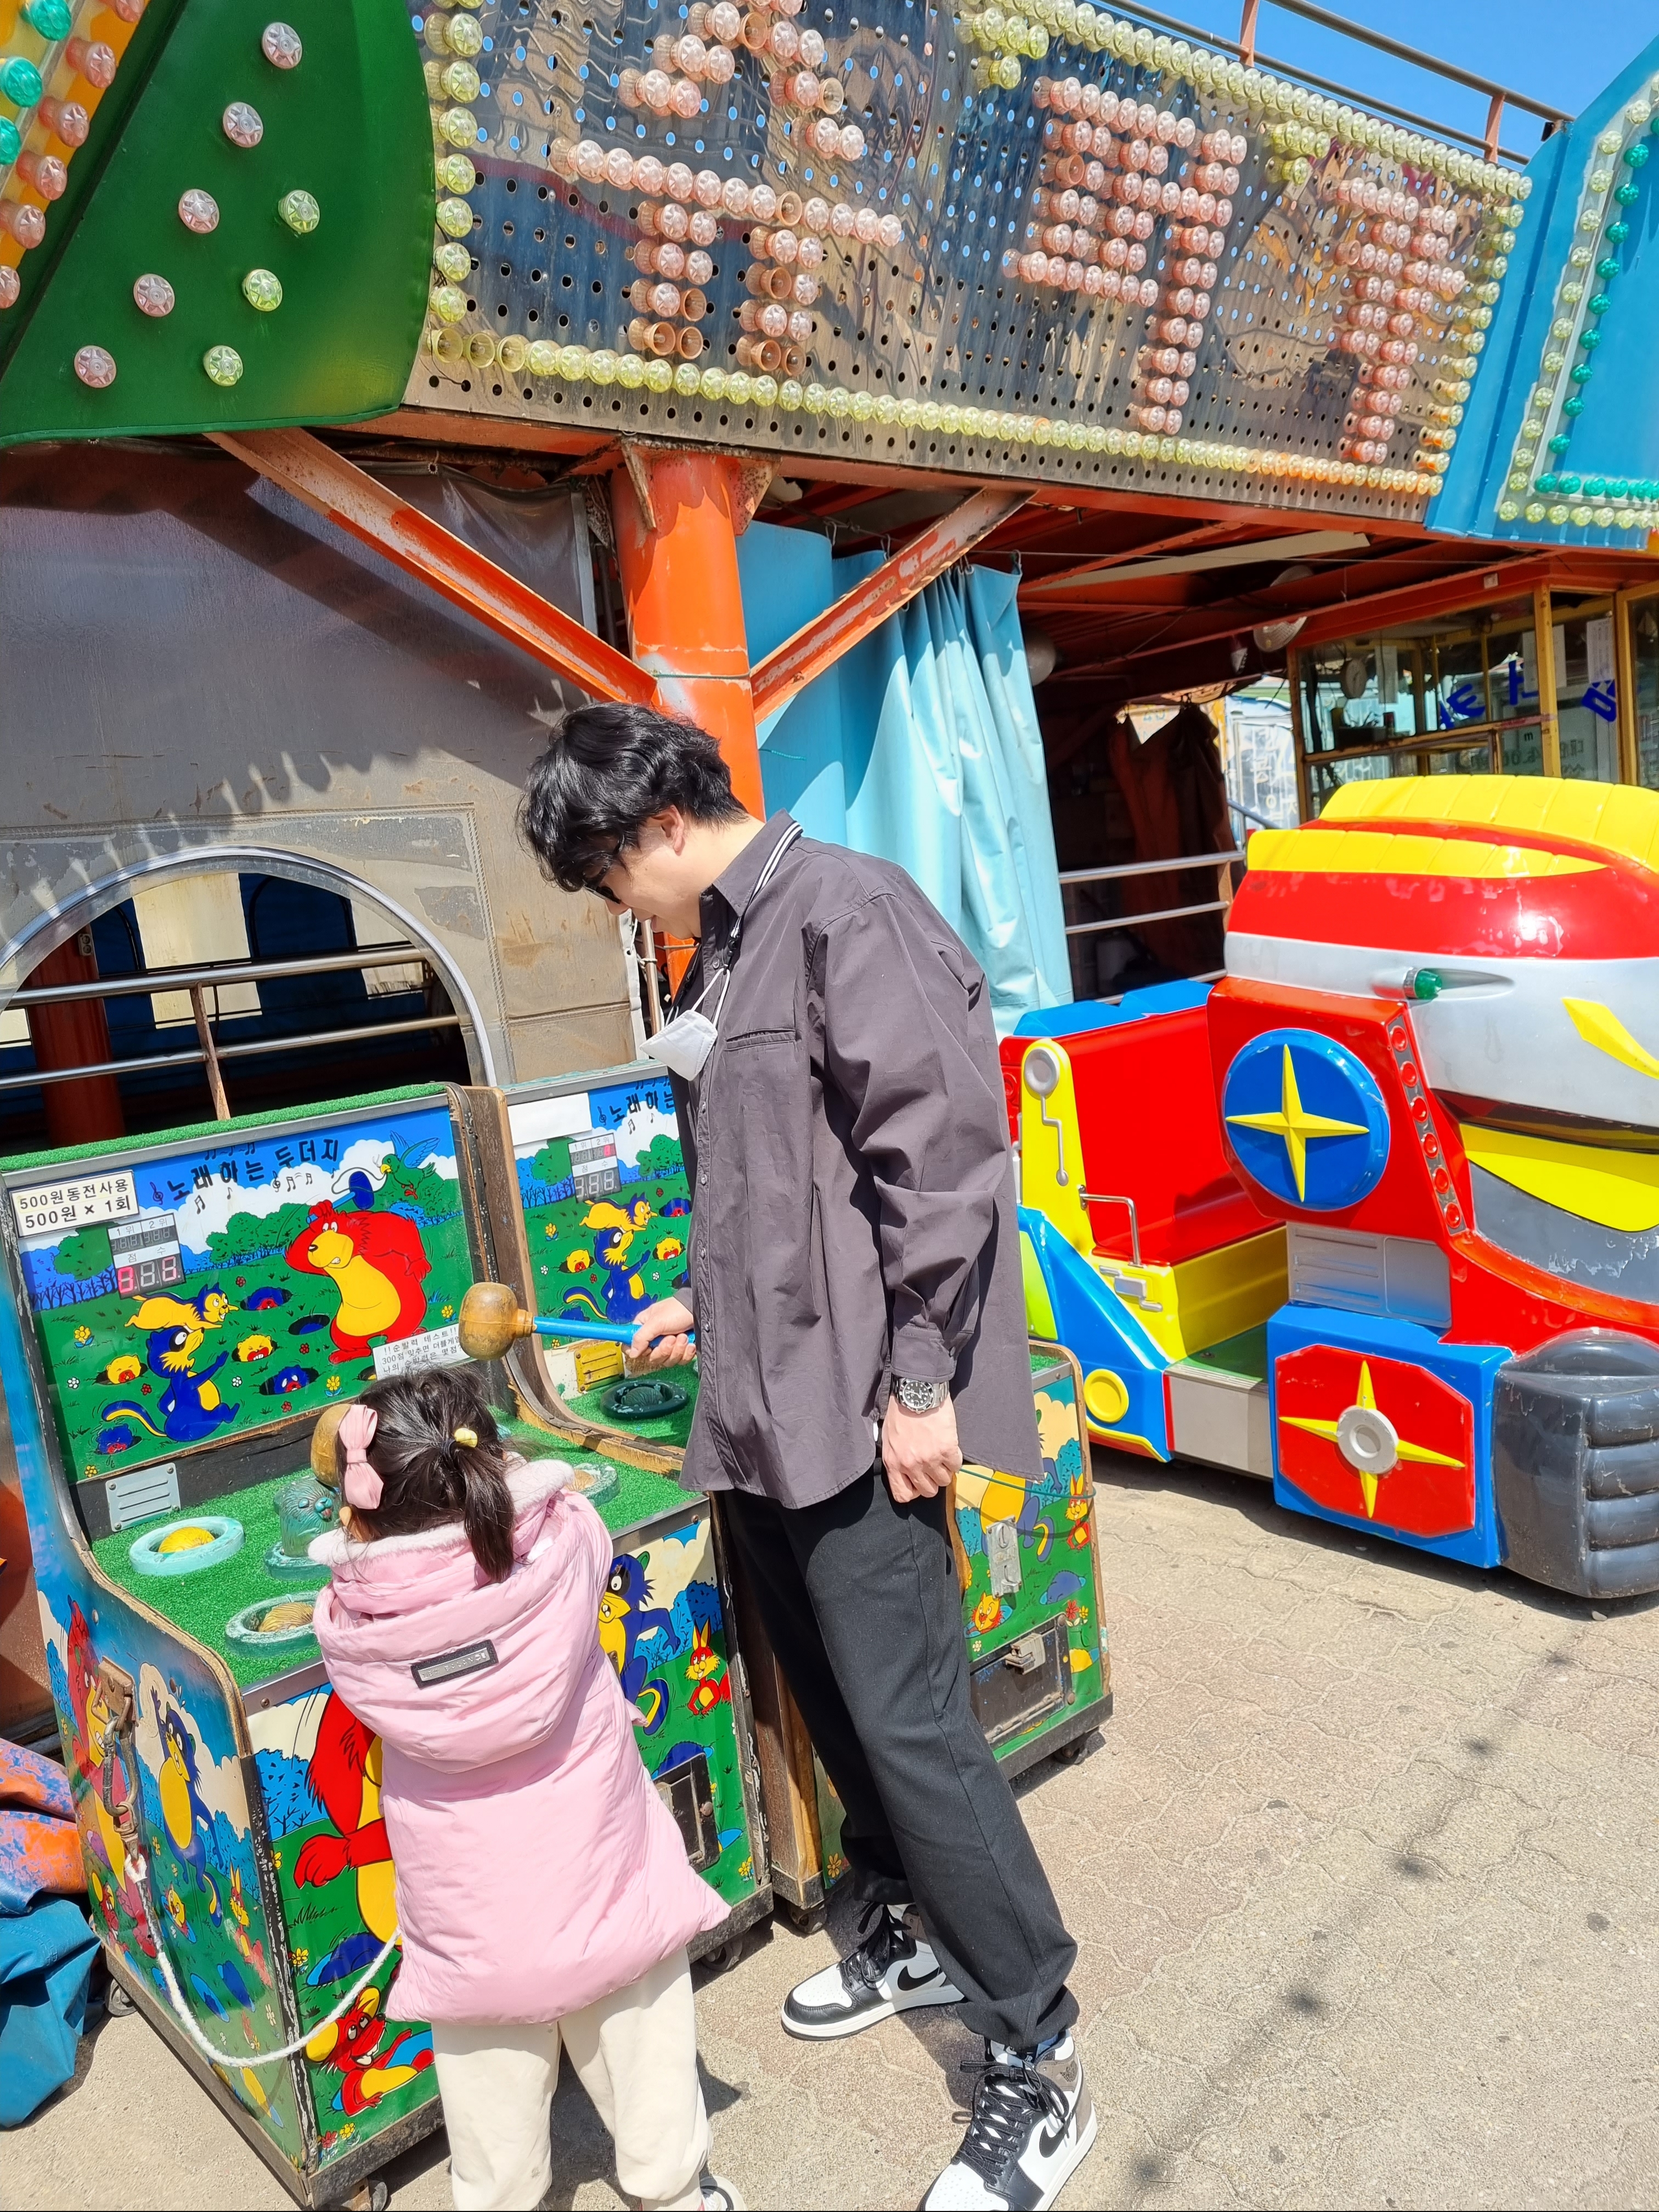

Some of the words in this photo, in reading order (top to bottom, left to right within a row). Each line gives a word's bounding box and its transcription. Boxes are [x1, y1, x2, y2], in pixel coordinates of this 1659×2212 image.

[609, 1090, 674, 1122] 노래하는
[167, 1160, 264, 1201] 노래하는
[275, 1139, 338, 1168] 두더지
[20, 1178, 129, 1210] 500원동전사용
[25, 1205, 77, 1228] 500원
[105, 1195, 132, 1213] 1회
[382, 1353, 404, 1365] 300점
[383, 1363, 399, 1373] 나의
